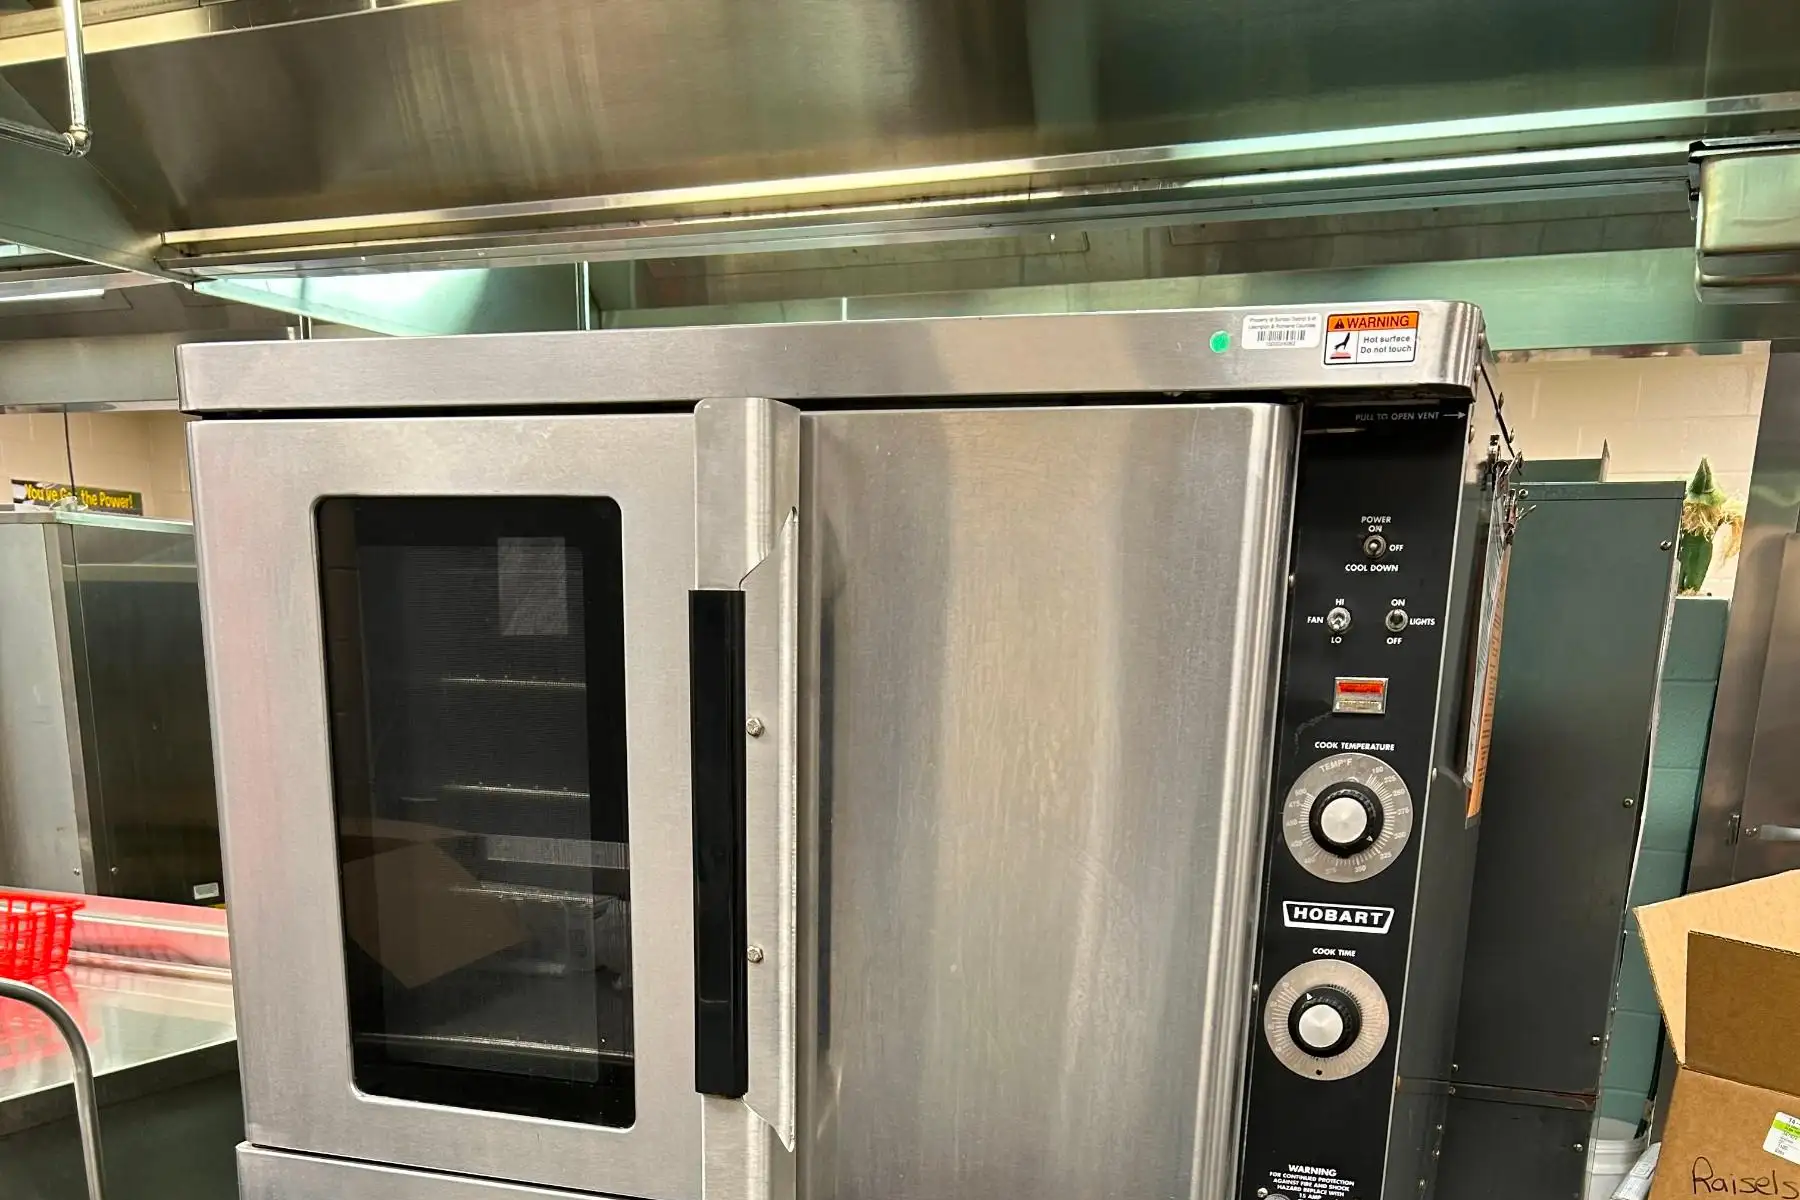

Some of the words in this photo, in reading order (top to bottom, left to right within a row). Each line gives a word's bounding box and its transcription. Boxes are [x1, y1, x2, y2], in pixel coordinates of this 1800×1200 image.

[1347, 316, 1409, 328] WARNING
[1364, 336, 1378, 344] Hot
[1360, 346, 1372, 354] Do
[1391, 412, 1414, 420] OPEN
[1417, 412, 1440, 420] VENT
[81, 490, 97, 506] the
[99, 491, 134, 508] Power!
[1361, 516, 1392, 524] POWER
[1389, 544, 1404, 552] OFF
[1345, 564, 1368, 572] COOL
[1370, 564, 1399, 572] DOWN
[1307, 616, 1324, 624] FAN
[1409, 618, 1436, 626] LIGHTS
[1331, 636, 1342, 644] LO
[1386, 637, 1402, 645] OFF
[1314, 741, 1338, 749] COOK
[1341, 742, 1396, 751] TEMPERATURE
[1294, 906, 1384, 925] HOBART
[1312, 947, 1336, 956] COOK
[1338, 948, 1356, 957] TIME
[1288, 1164, 1337, 1177] WARNING
[1282, 1173, 1316, 1182] CONTINUED
[1318, 1178, 1354, 1186] PROTECTION
[1273, 1178, 1299, 1186] AGAINST
[1328, 1184, 1350, 1192] SHOCK
[1303, 1188, 1327, 1196] REPLACE
